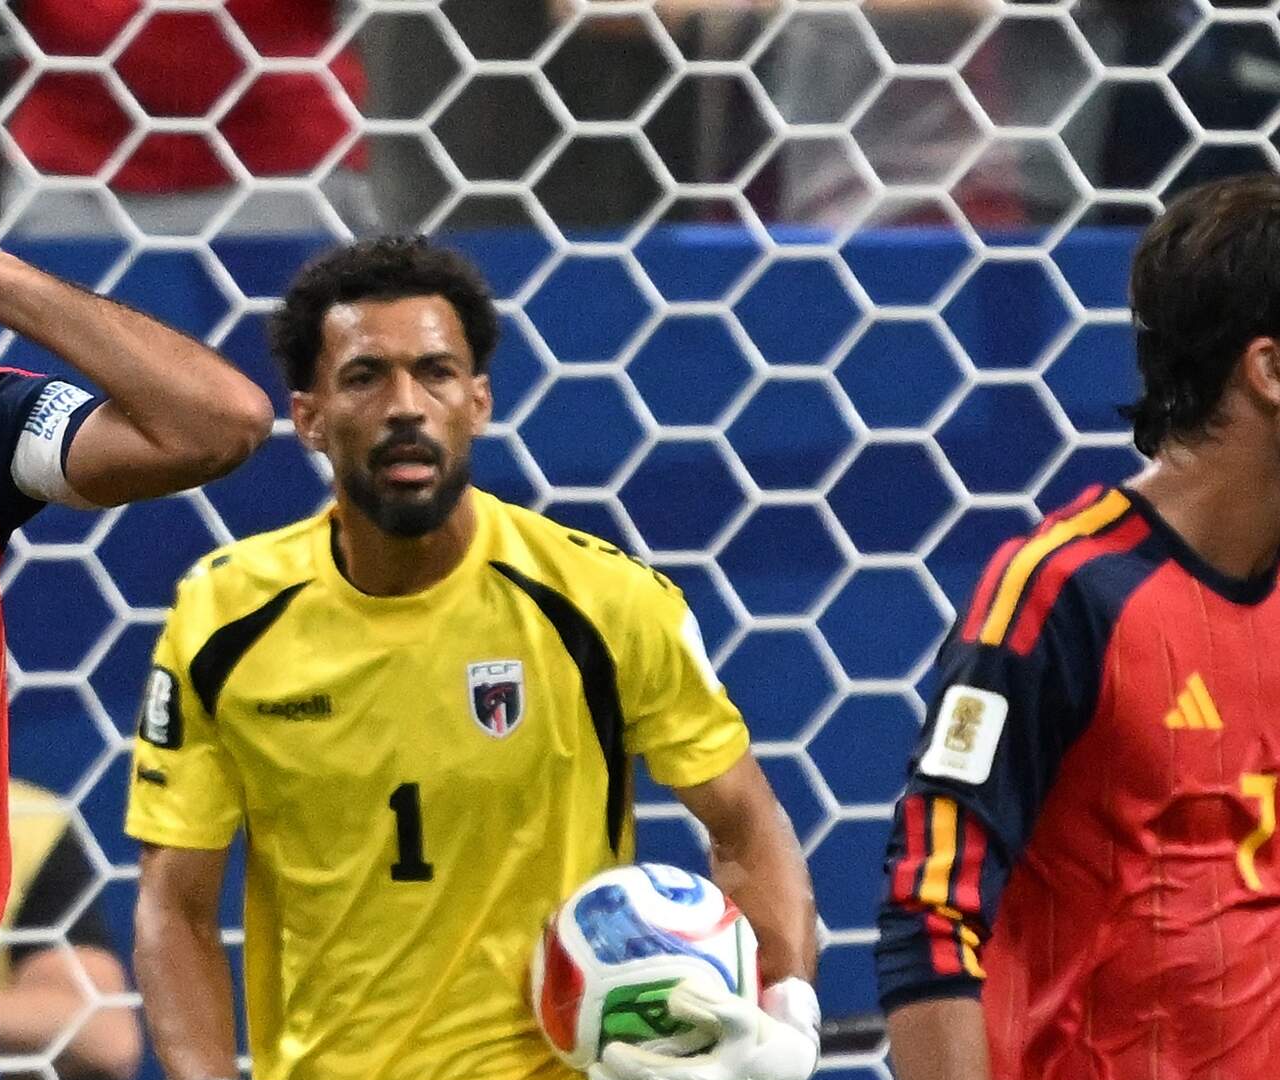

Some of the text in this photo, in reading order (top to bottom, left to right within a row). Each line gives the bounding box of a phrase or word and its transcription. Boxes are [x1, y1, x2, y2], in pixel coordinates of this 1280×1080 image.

[471, 662, 519, 677] FCF
[389, 782, 434, 882] 1
[1239, 773, 1278, 893] 7
